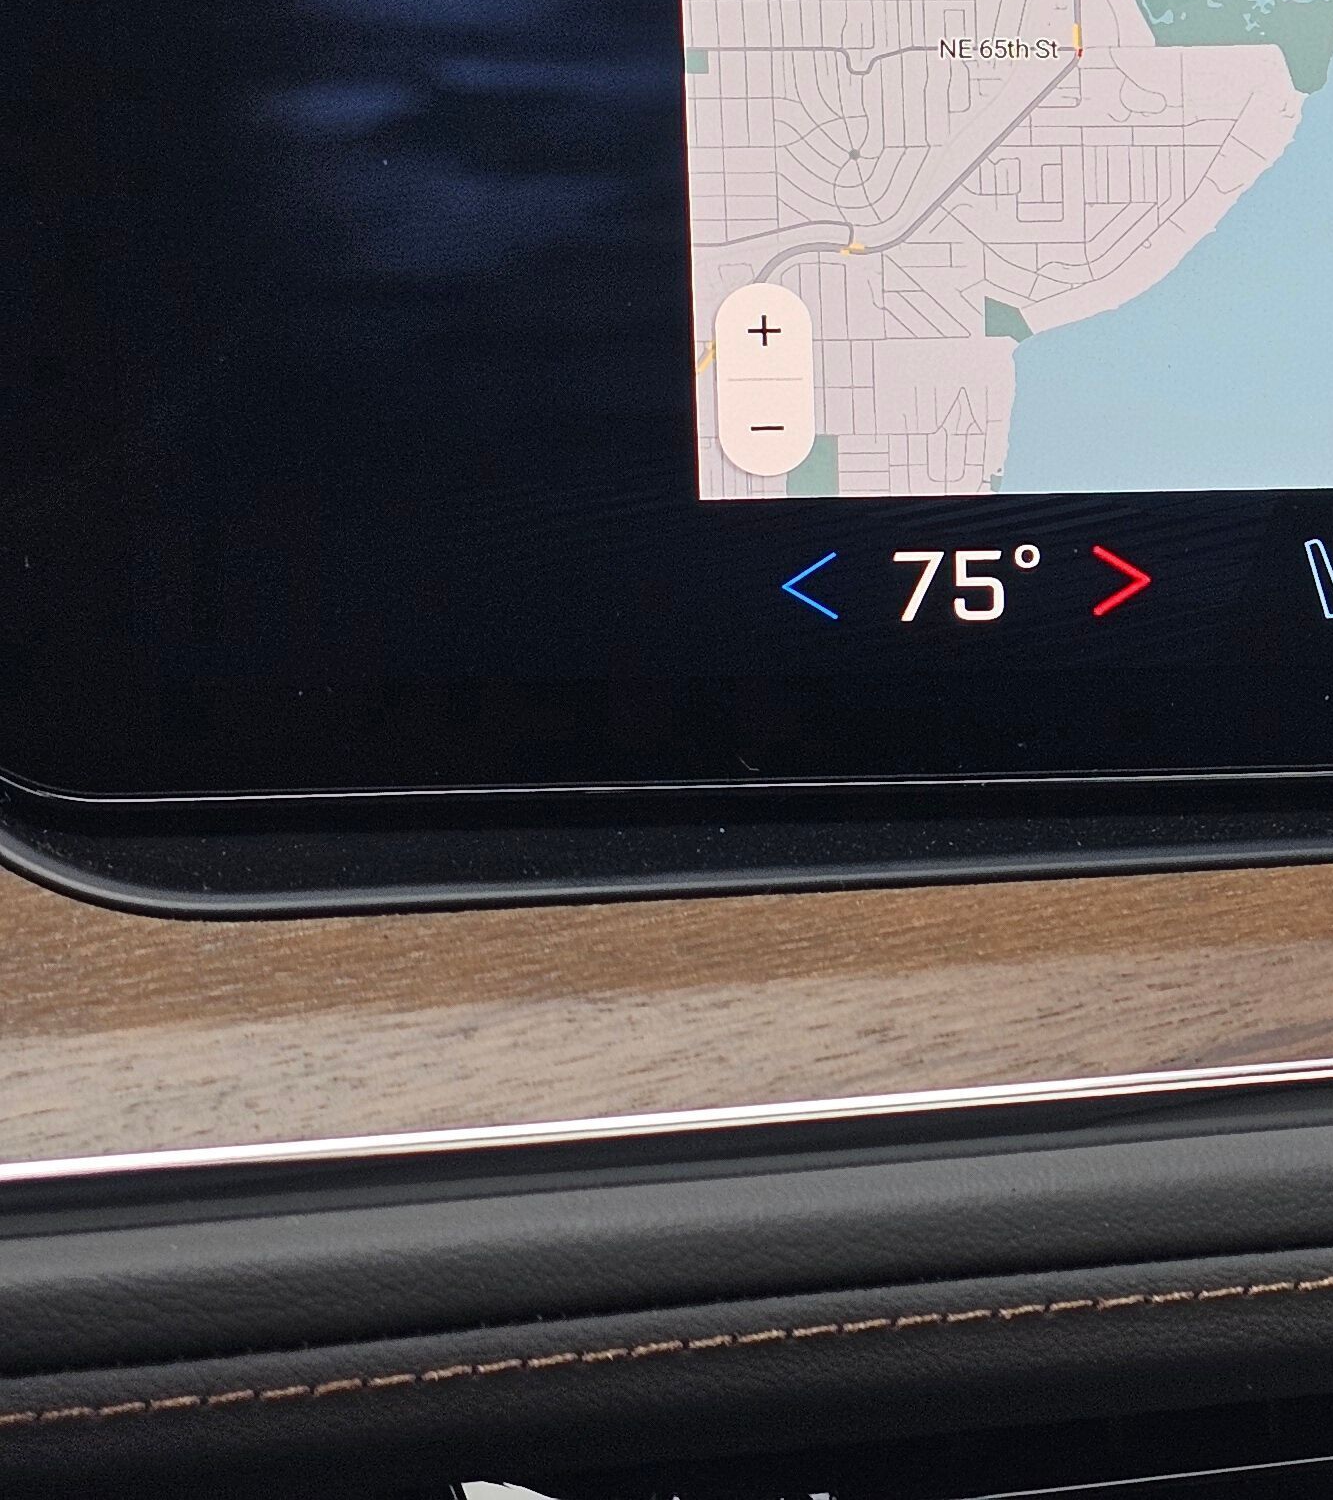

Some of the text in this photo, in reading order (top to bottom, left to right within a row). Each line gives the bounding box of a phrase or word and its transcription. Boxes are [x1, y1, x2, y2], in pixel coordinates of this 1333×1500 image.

[940, 39, 1059, 60] NE 65th St
[892, 545, 1041, 622] 75°
